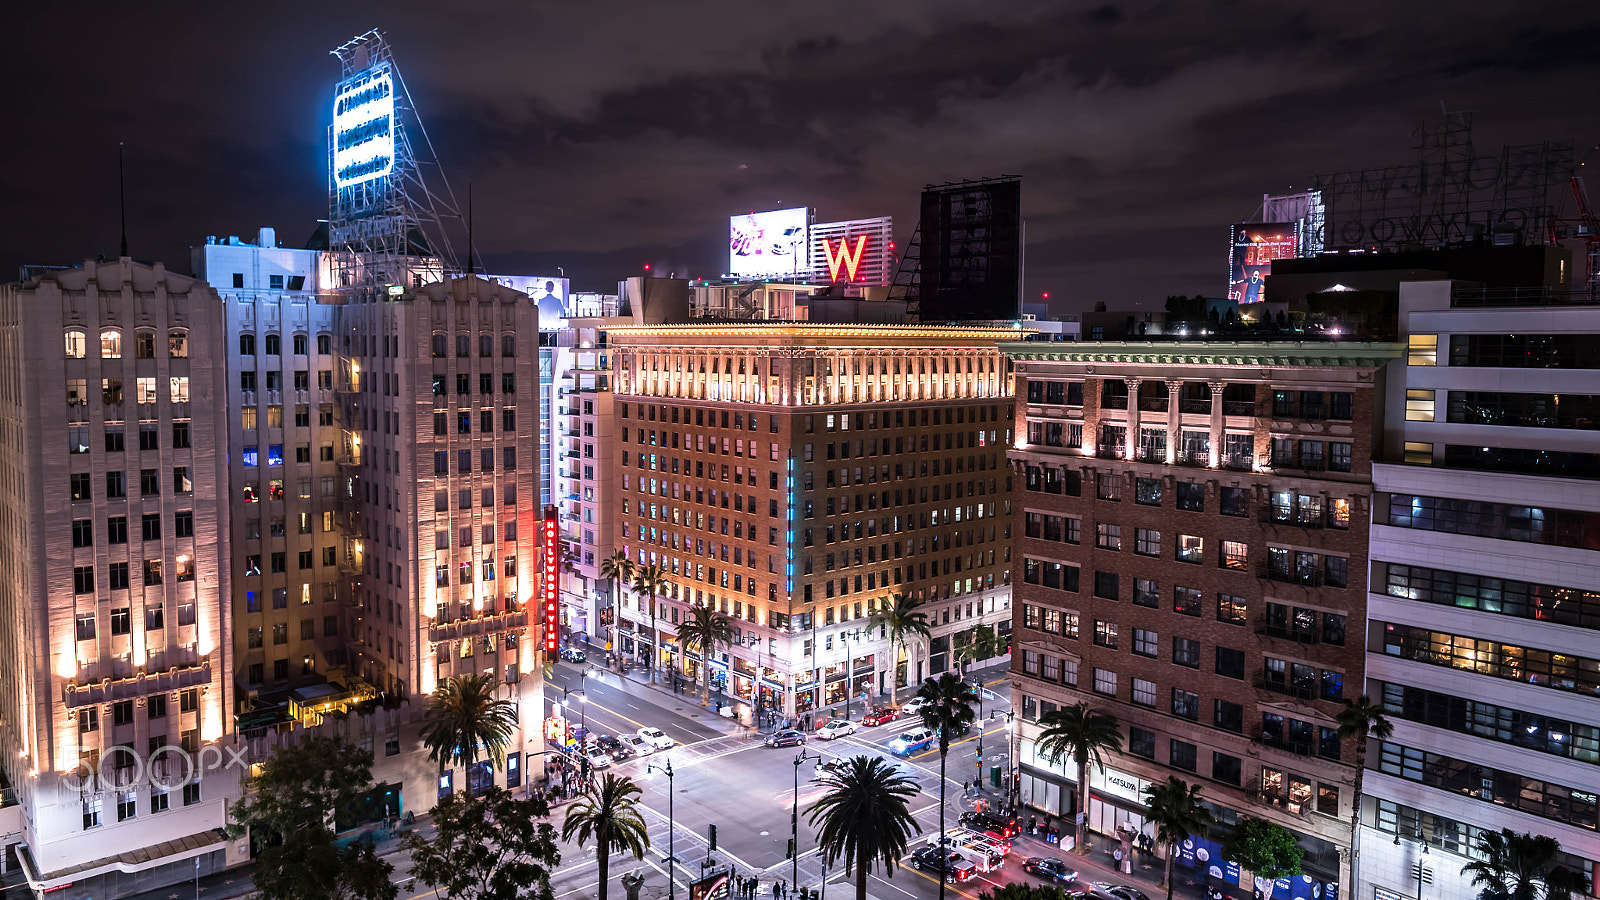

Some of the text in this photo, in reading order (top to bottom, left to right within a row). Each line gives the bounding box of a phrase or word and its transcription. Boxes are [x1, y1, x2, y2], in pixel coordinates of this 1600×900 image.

[821, 235, 867, 283] W
[546, 522, 555, 598] HOLLYWOOD
[547, 615, 555, 648] VINE
[1108, 775, 1136, 791] KATSUYA
